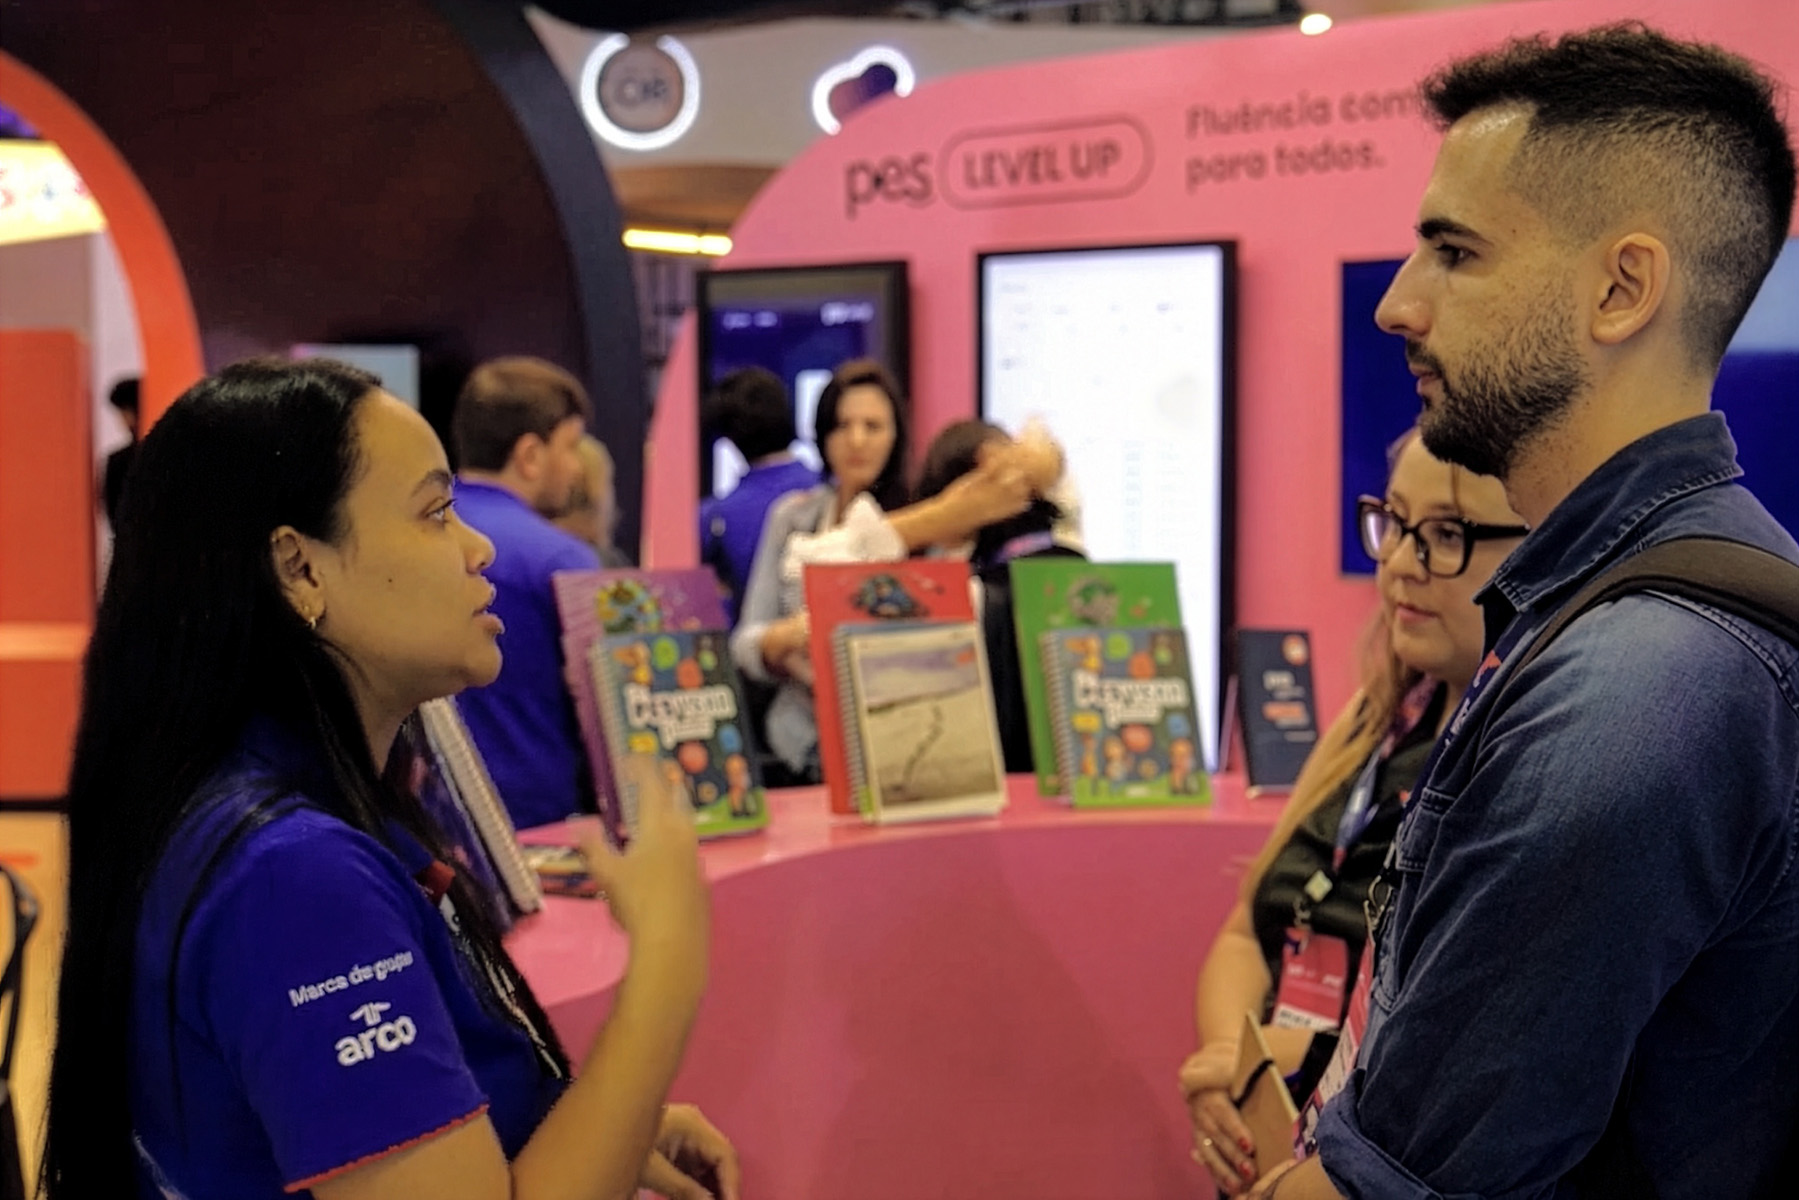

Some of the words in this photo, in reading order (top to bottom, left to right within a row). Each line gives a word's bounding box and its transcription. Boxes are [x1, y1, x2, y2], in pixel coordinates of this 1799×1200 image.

[844, 153, 932, 221] pes
[963, 144, 1060, 190] LEVEL
[1069, 138, 1122, 179] UP
[1186, 152, 1268, 195] para
[1274, 137, 1388, 177] todos.
[335, 1015, 417, 1066] arco
